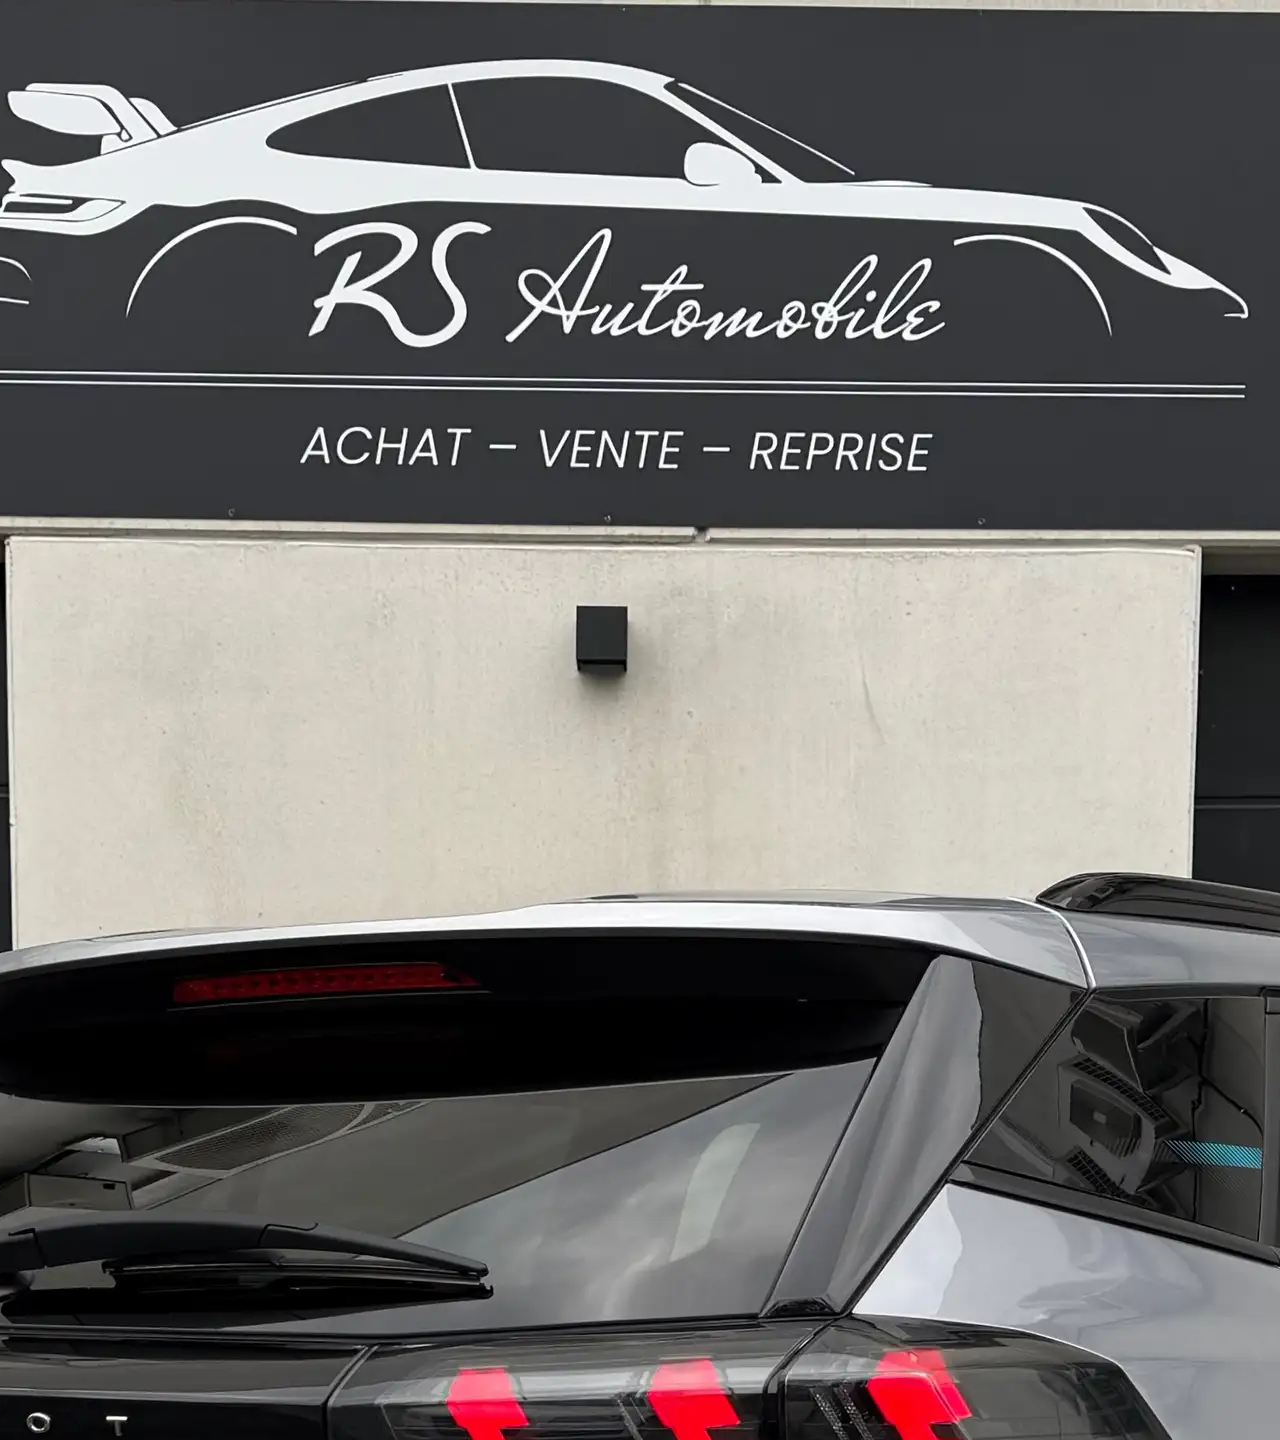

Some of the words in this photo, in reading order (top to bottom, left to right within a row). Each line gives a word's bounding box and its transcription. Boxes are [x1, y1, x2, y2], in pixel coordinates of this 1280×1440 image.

[308, 221, 493, 348] RS
[505, 228, 947, 343] Automobile
[300, 426, 473, 467] ACHAT
[538, 429, 685, 470] VENTE
[748, 431, 935, 472] REPRISE
